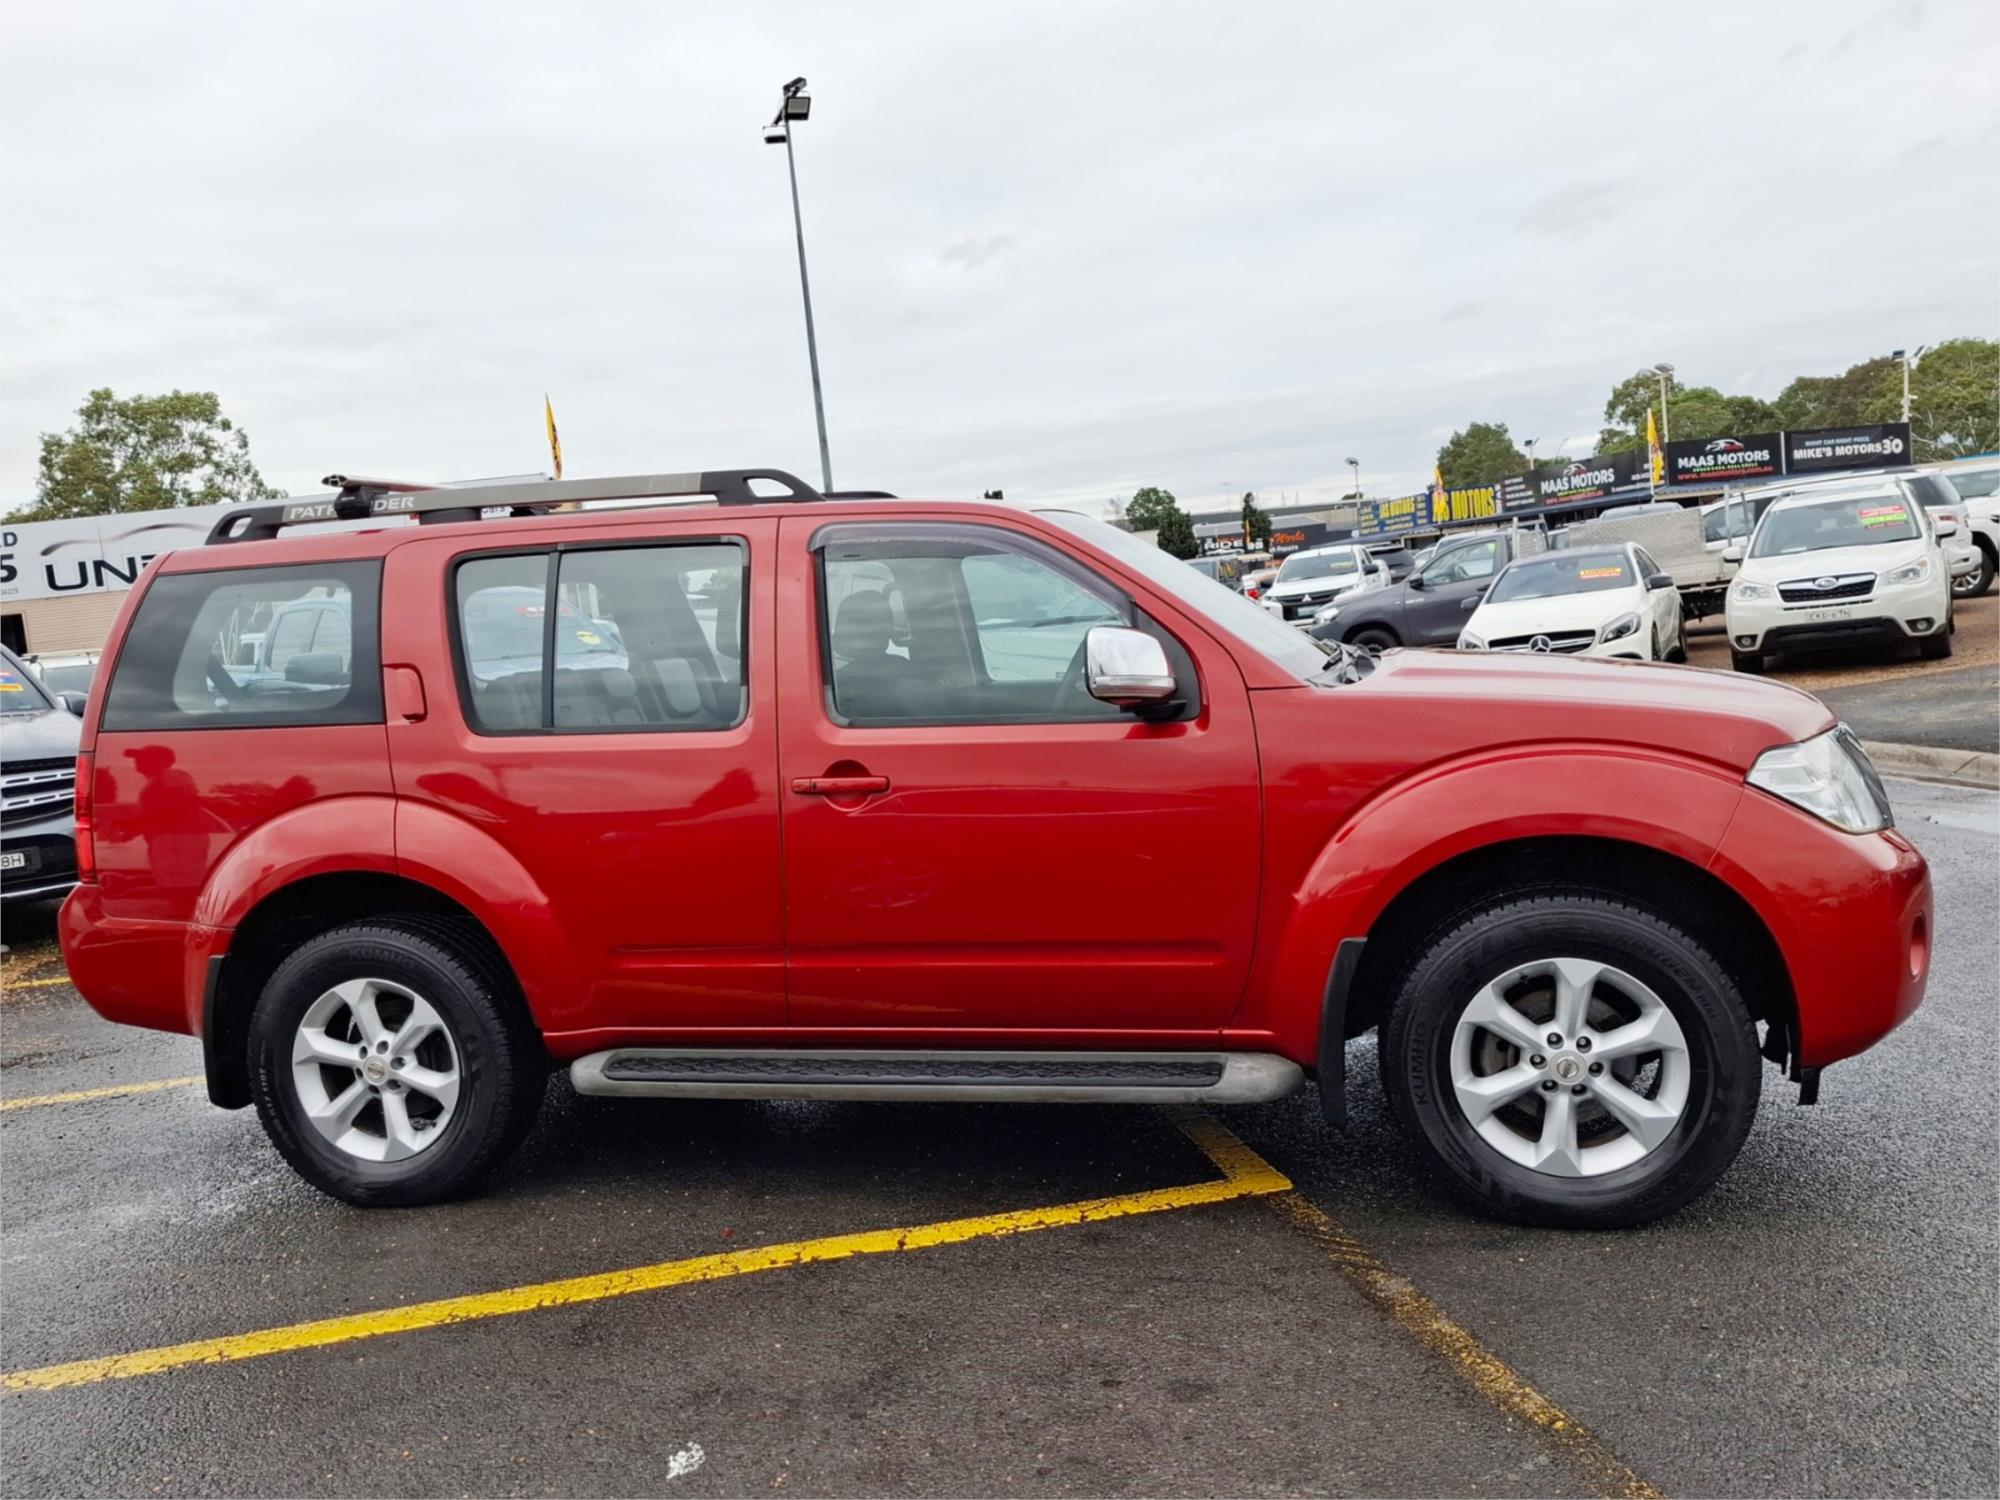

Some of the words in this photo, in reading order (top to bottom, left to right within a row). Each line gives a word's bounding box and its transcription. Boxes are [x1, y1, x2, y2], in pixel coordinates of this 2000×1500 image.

[1793, 446, 1833, 460] MIKE'S
[1835, 442, 1881, 456] MOTORS
[1882, 437, 1904, 454] 30
[1678, 454, 1715, 469] MAAS
[1717, 450, 1770, 465] MOTORS
[1541, 476, 1569, 494] MAAS
[1571, 468, 1615, 488] MOTORS
[290, 496, 414, 519] PATHDER
[1451, 486, 1495, 520] MOTORS
[0, 532, 18, 547] D
[1204, 539, 1244, 550] RIDE
[1410, 1021, 1429, 1106] KUMHO
